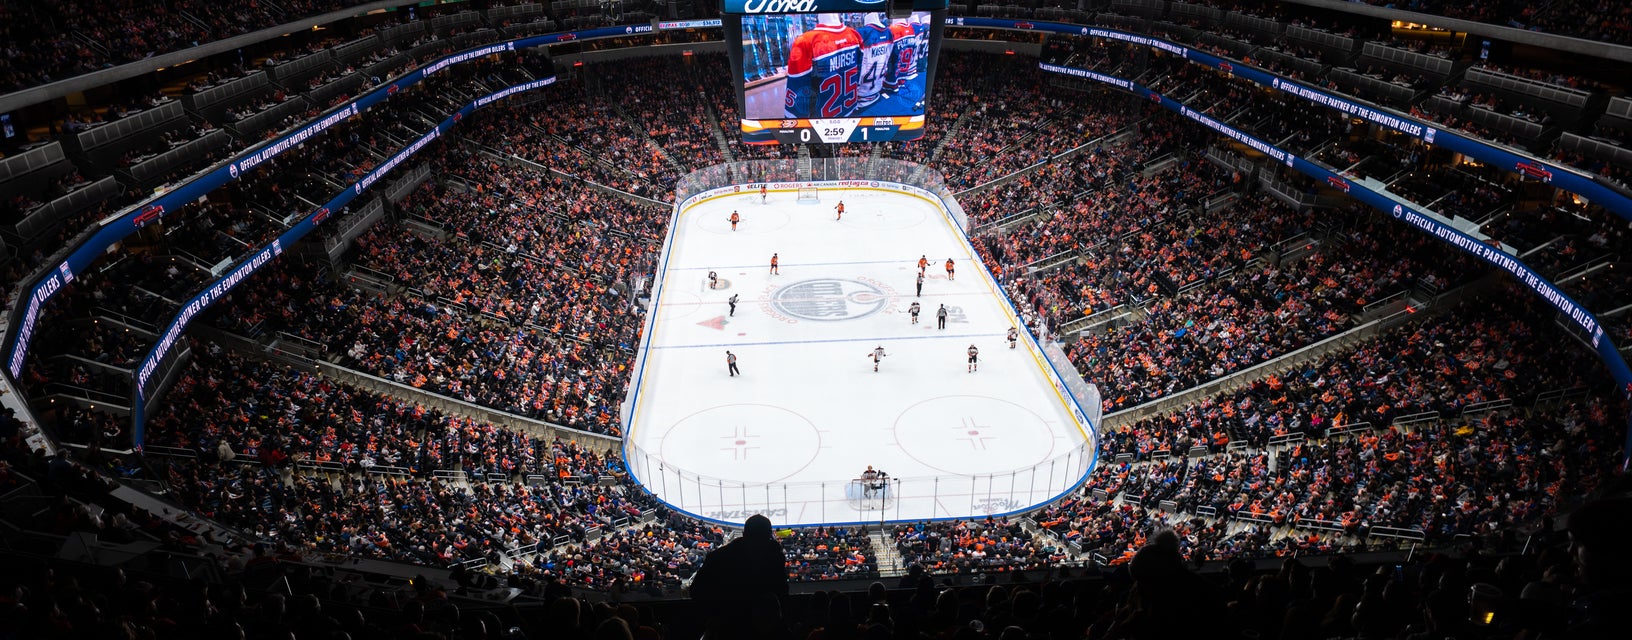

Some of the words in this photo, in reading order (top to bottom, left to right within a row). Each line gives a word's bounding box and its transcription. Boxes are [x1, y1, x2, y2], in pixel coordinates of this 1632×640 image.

[830, 51, 857, 72] NURSE
[820, 66, 858, 117] 25
[1280, 82, 1299, 95] OFFICIAL
[1300, 86, 1327, 104] AUTOMOTIVE
[1328, 98, 1349, 112] PARTNER
[1350, 105, 1357, 114] OF
[1358, 107, 1369, 118] THE
[1369, 111, 1399, 129] EDMONTON
[1400, 121, 1422, 136] OILERS
[240, 154, 262, 171] OFFICIAL
[262, 142, 290, 160] AUTOMOTIVE
[290, 131, 307, 146] PARTNER
[307, 128, 313, 136] OF
[313, 123, 321, 133] THE
[320, 114, 340, 129] EDMONTON
[340, 108, 351, 120] OILERS
[801, 129, 810, 142] 0
[824, 128, 844, 136] 2:59
[861, 127, 868, 140] 1
[1220, 124, 1235, 137] PARTNER
[1270, 147, 1284, 160] OILERS
[38, 274, 60, 302] OILERS
[1405, 211, 1434, 233] OFFICIAL
[1435, 226, 1482, 255] AUTOMOTIVE
[1483, 249, 1517, 273] PARTNER
[1517, 267, 1526, 278] OF
[1525, 272, 1537, 288] THE
[1537, 281, 1574, 314] EDMONTON
[1573, 307, 1595, 333] OILERS
[155, 321, 181, 362] AUTOMOTIVE
[179, 300, 200, 328] PARTNER
[200, 293, 210, 307] OF
[210, 283, 222, 300] THE
[222, 261, 252, 291] EDMONTON
[252, 249, 270, 268] OILERS
